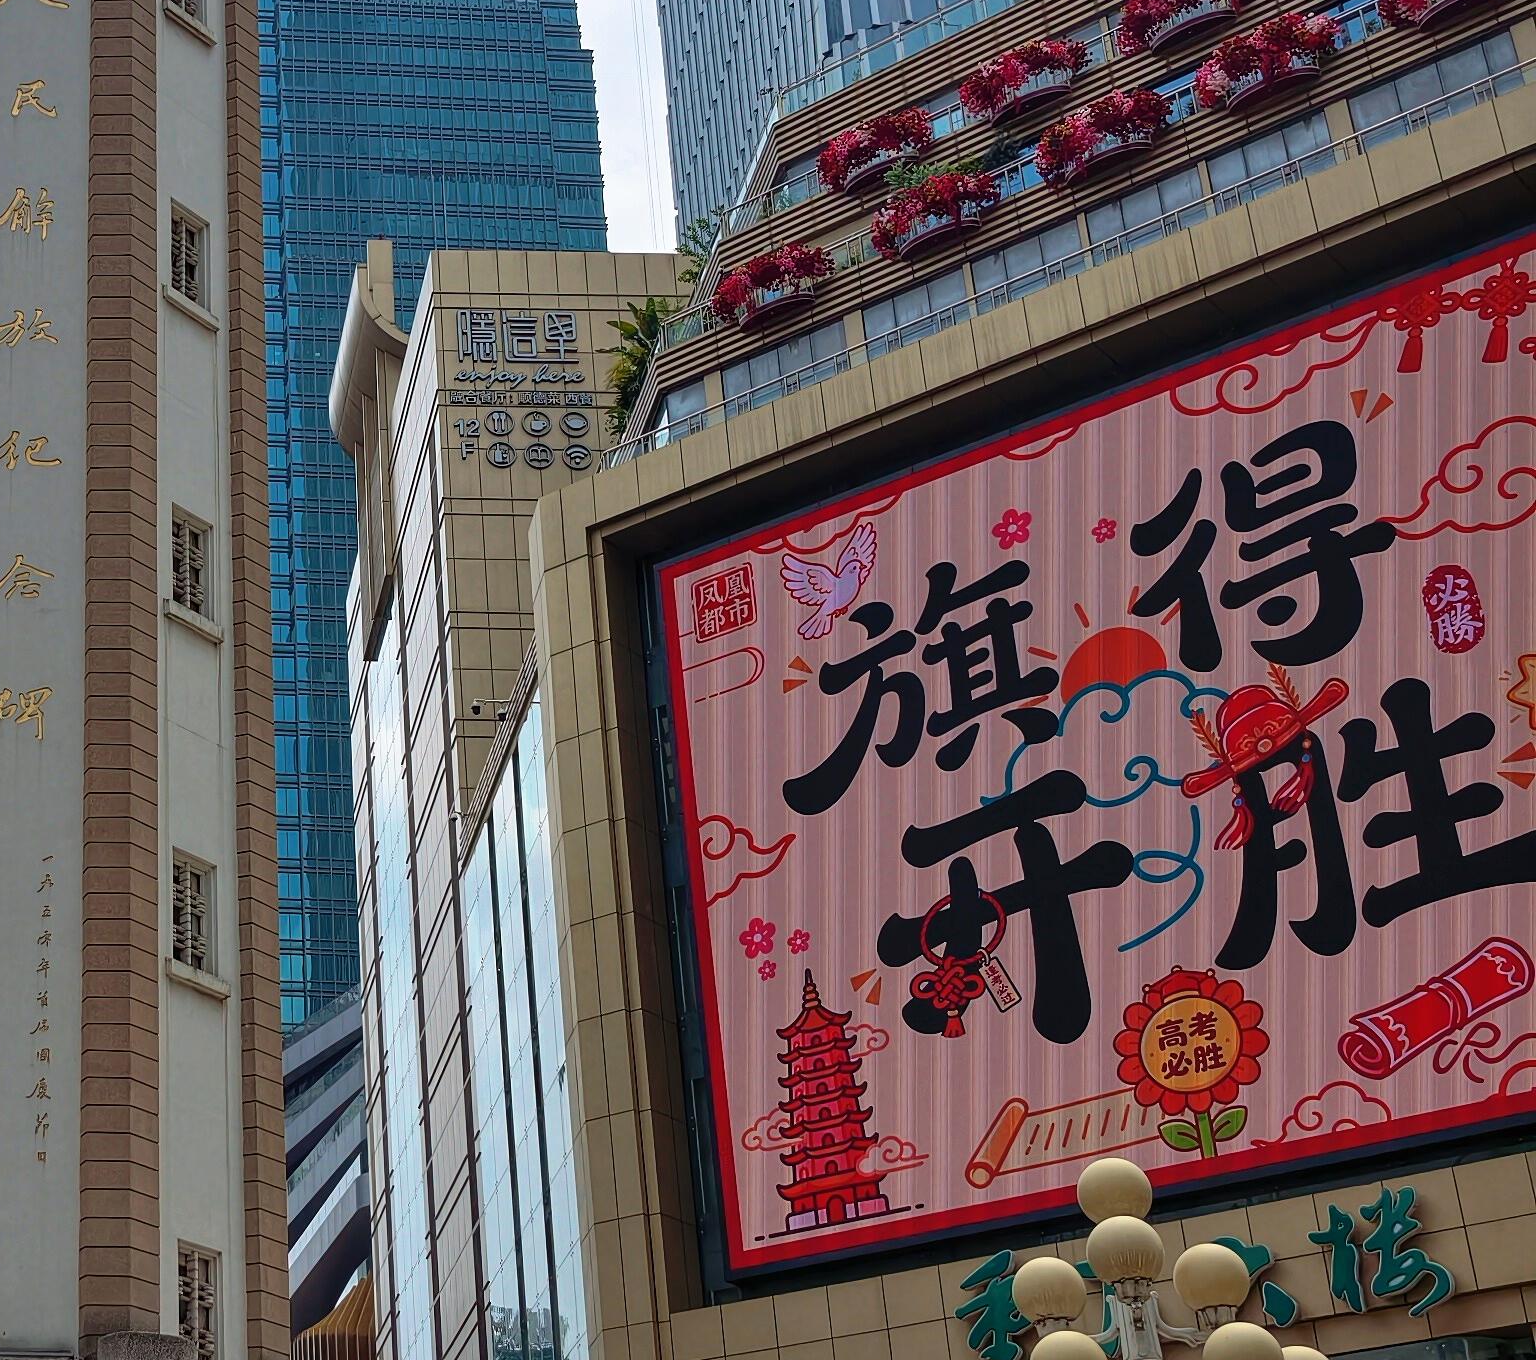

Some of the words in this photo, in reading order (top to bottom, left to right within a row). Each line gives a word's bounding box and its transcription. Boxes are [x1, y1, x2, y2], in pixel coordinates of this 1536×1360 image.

[454, 365, 527, 389] enjoy
[531, 364, 585, 383] here
[453, 419, 481, 438] 12
[461, 441, 475, 460] F
[698, 571, 750, 611] 凤凰
[1156, 1011, 1218, 1051] 高考
[1161, 1043, 1227, 1080] 必胜
